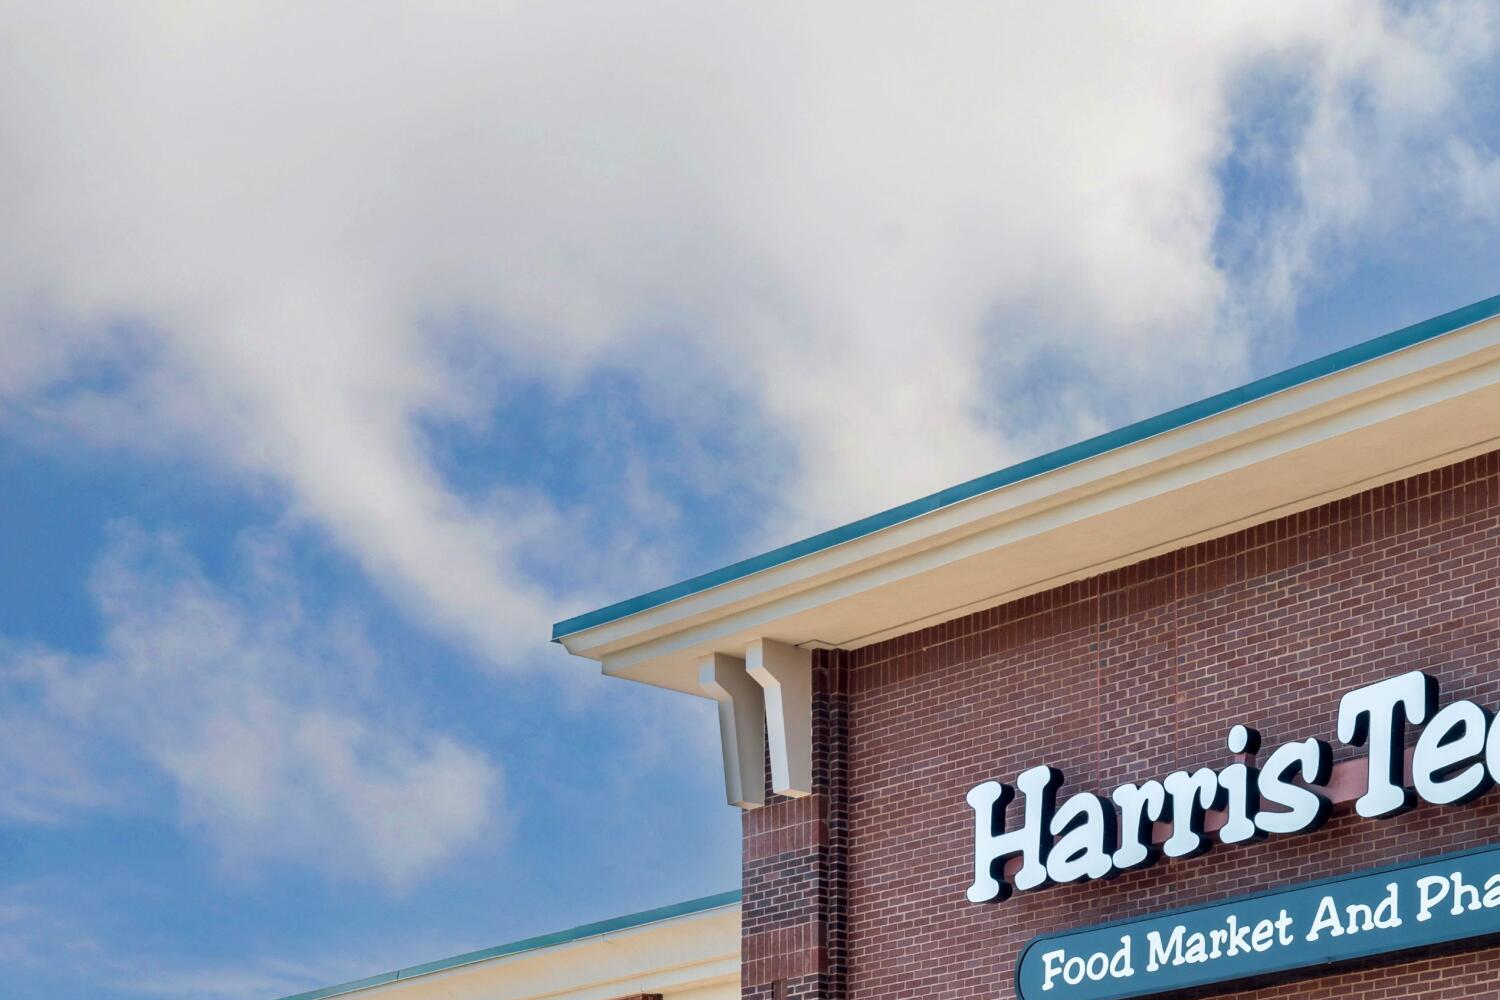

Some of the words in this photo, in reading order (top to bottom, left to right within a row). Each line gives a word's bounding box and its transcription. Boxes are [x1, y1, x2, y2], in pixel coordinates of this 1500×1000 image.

[966, 724, 1322, 904] Harris
[1041, 934, 1132, 991] Food
[1146, 908, 1293, 968] Market
[1306, 883, 1402, 941] And
